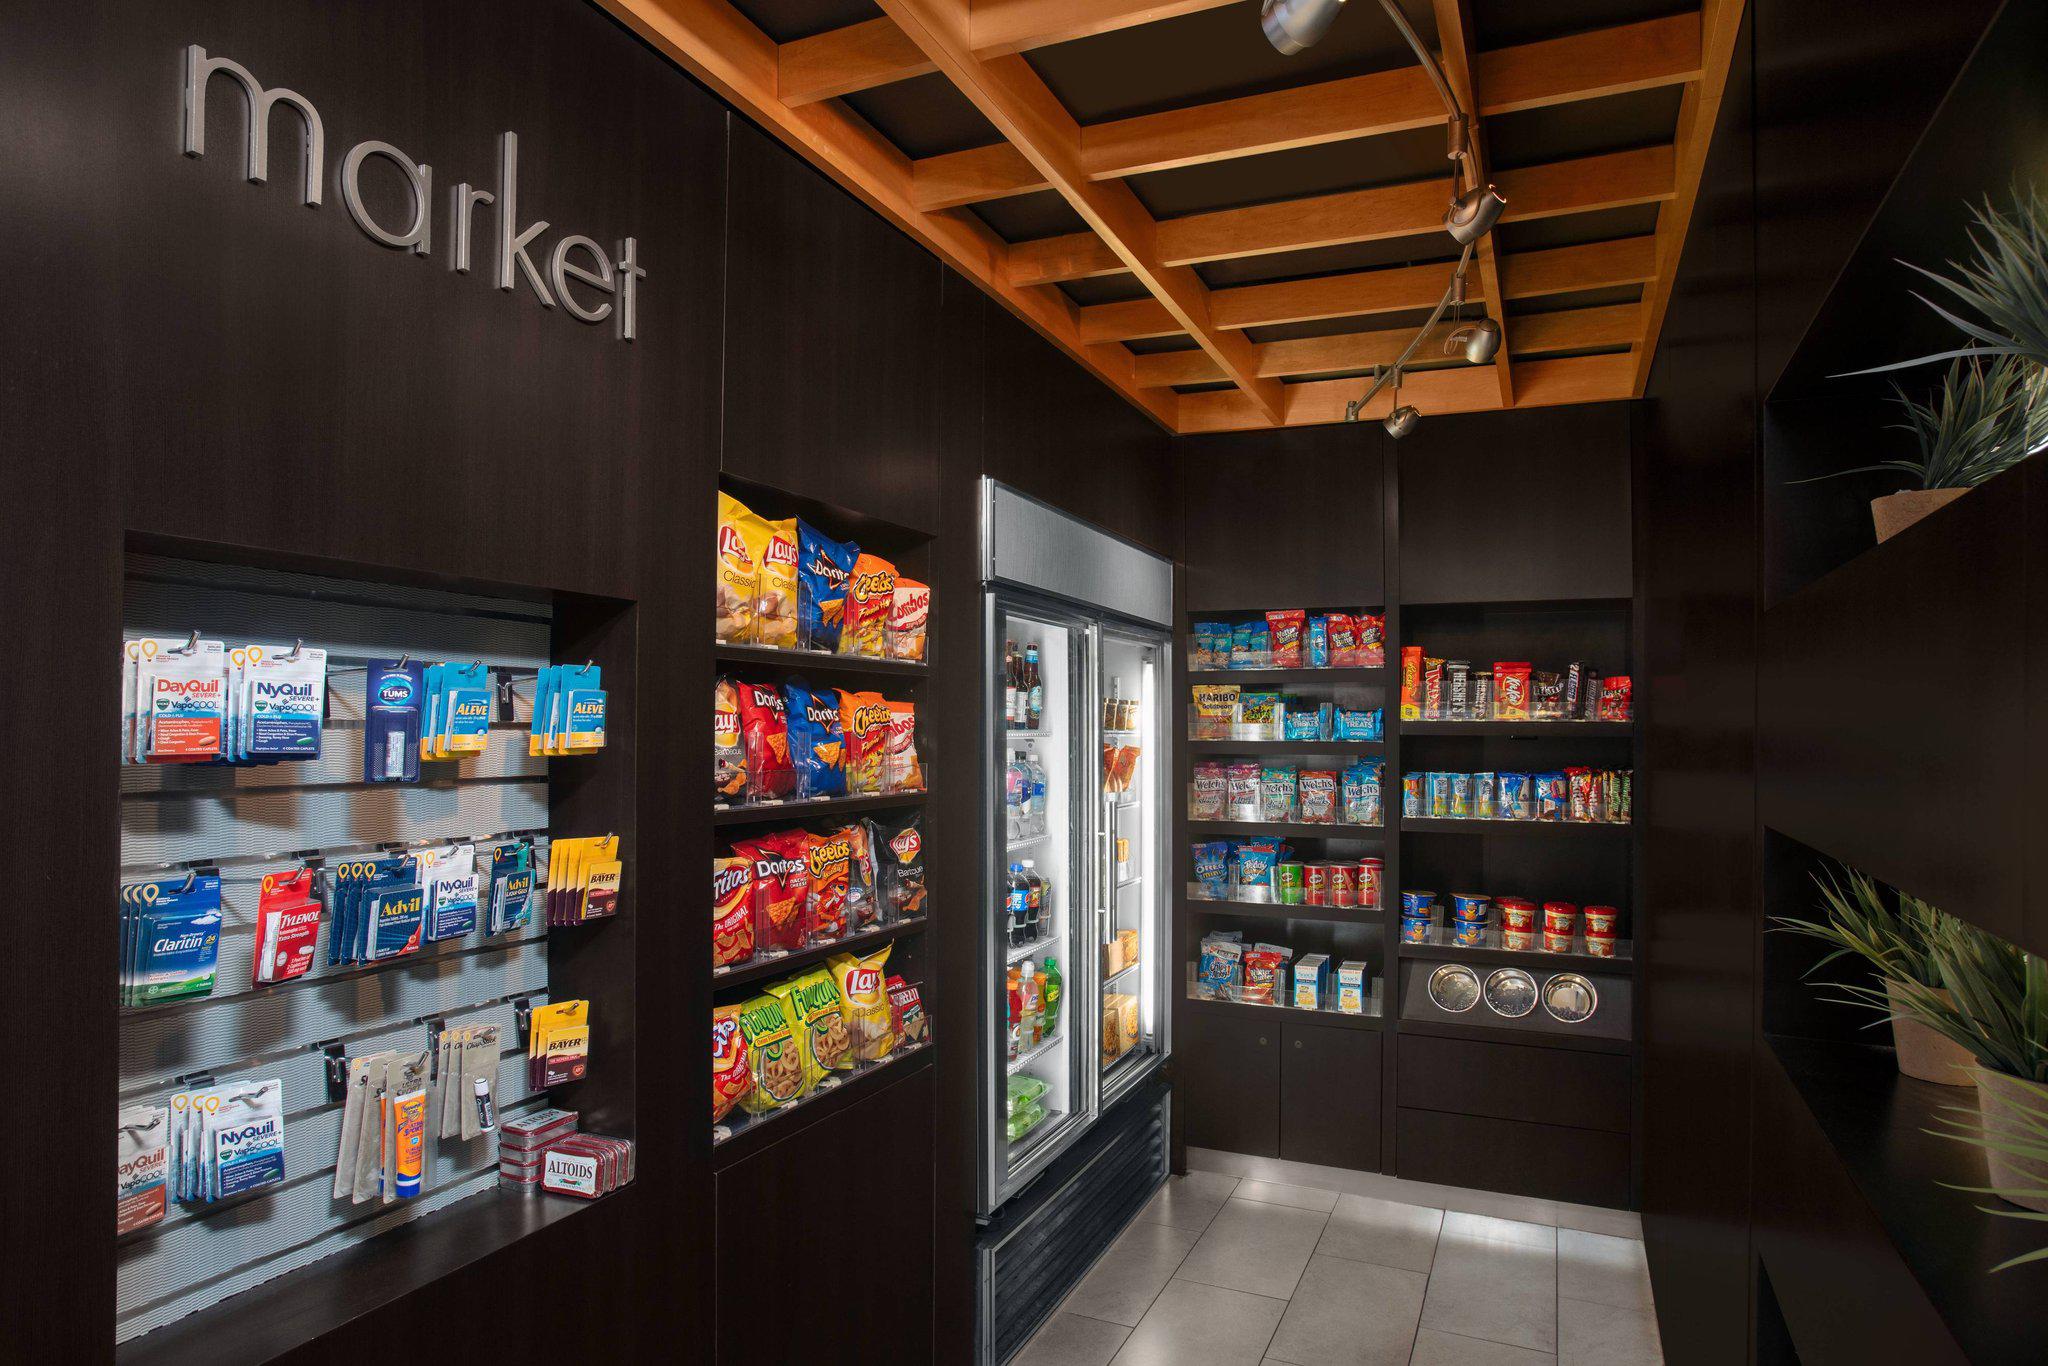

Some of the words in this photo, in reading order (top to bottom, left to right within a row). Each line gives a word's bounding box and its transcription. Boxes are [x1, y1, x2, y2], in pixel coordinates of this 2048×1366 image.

[184, 44, 646, 343] market
[723, 570, 756, 589] Classic
[157, 679, 219, 695] DayQuil
[257, 683, 312, 698] NyQuil
[382, 690, 409, 699] TUMS
[171, 701, 219, 710] VapoCOOL
[1199, 693, 1236, 702] HARIBO
[269, 703, 318, 712] VapoCOOL
[456, 703, 489, 716] ALEVE
[573, 702, 605, 715] ALEVE
[1196, 779, 1225, 790] Welch's
[1302, 780, 1333, 790] Welch's
[757, 859, 806, 878] Doritos
[440, 877, 473, 894] NyQuil
[508, 877, 529, 892] Advil
[590, 873, 616, 884] BAYER
[381, 897, 421, 917] Advil
[281, 911, 320, 930] TYLENOL
[724, 905, 750, 929] ORIGINAL
[154, 937, 203, 954] Claritin
[549, 1038, 582, 1051] BAYER
[221, 1121, 274, 1146] NyQuil
[234, 1139, 281, 1156] VapoCOOL
[118, 1148, 165, 1176] ayQuil
[548, 1160, 593, 1179] ALTOIDS
